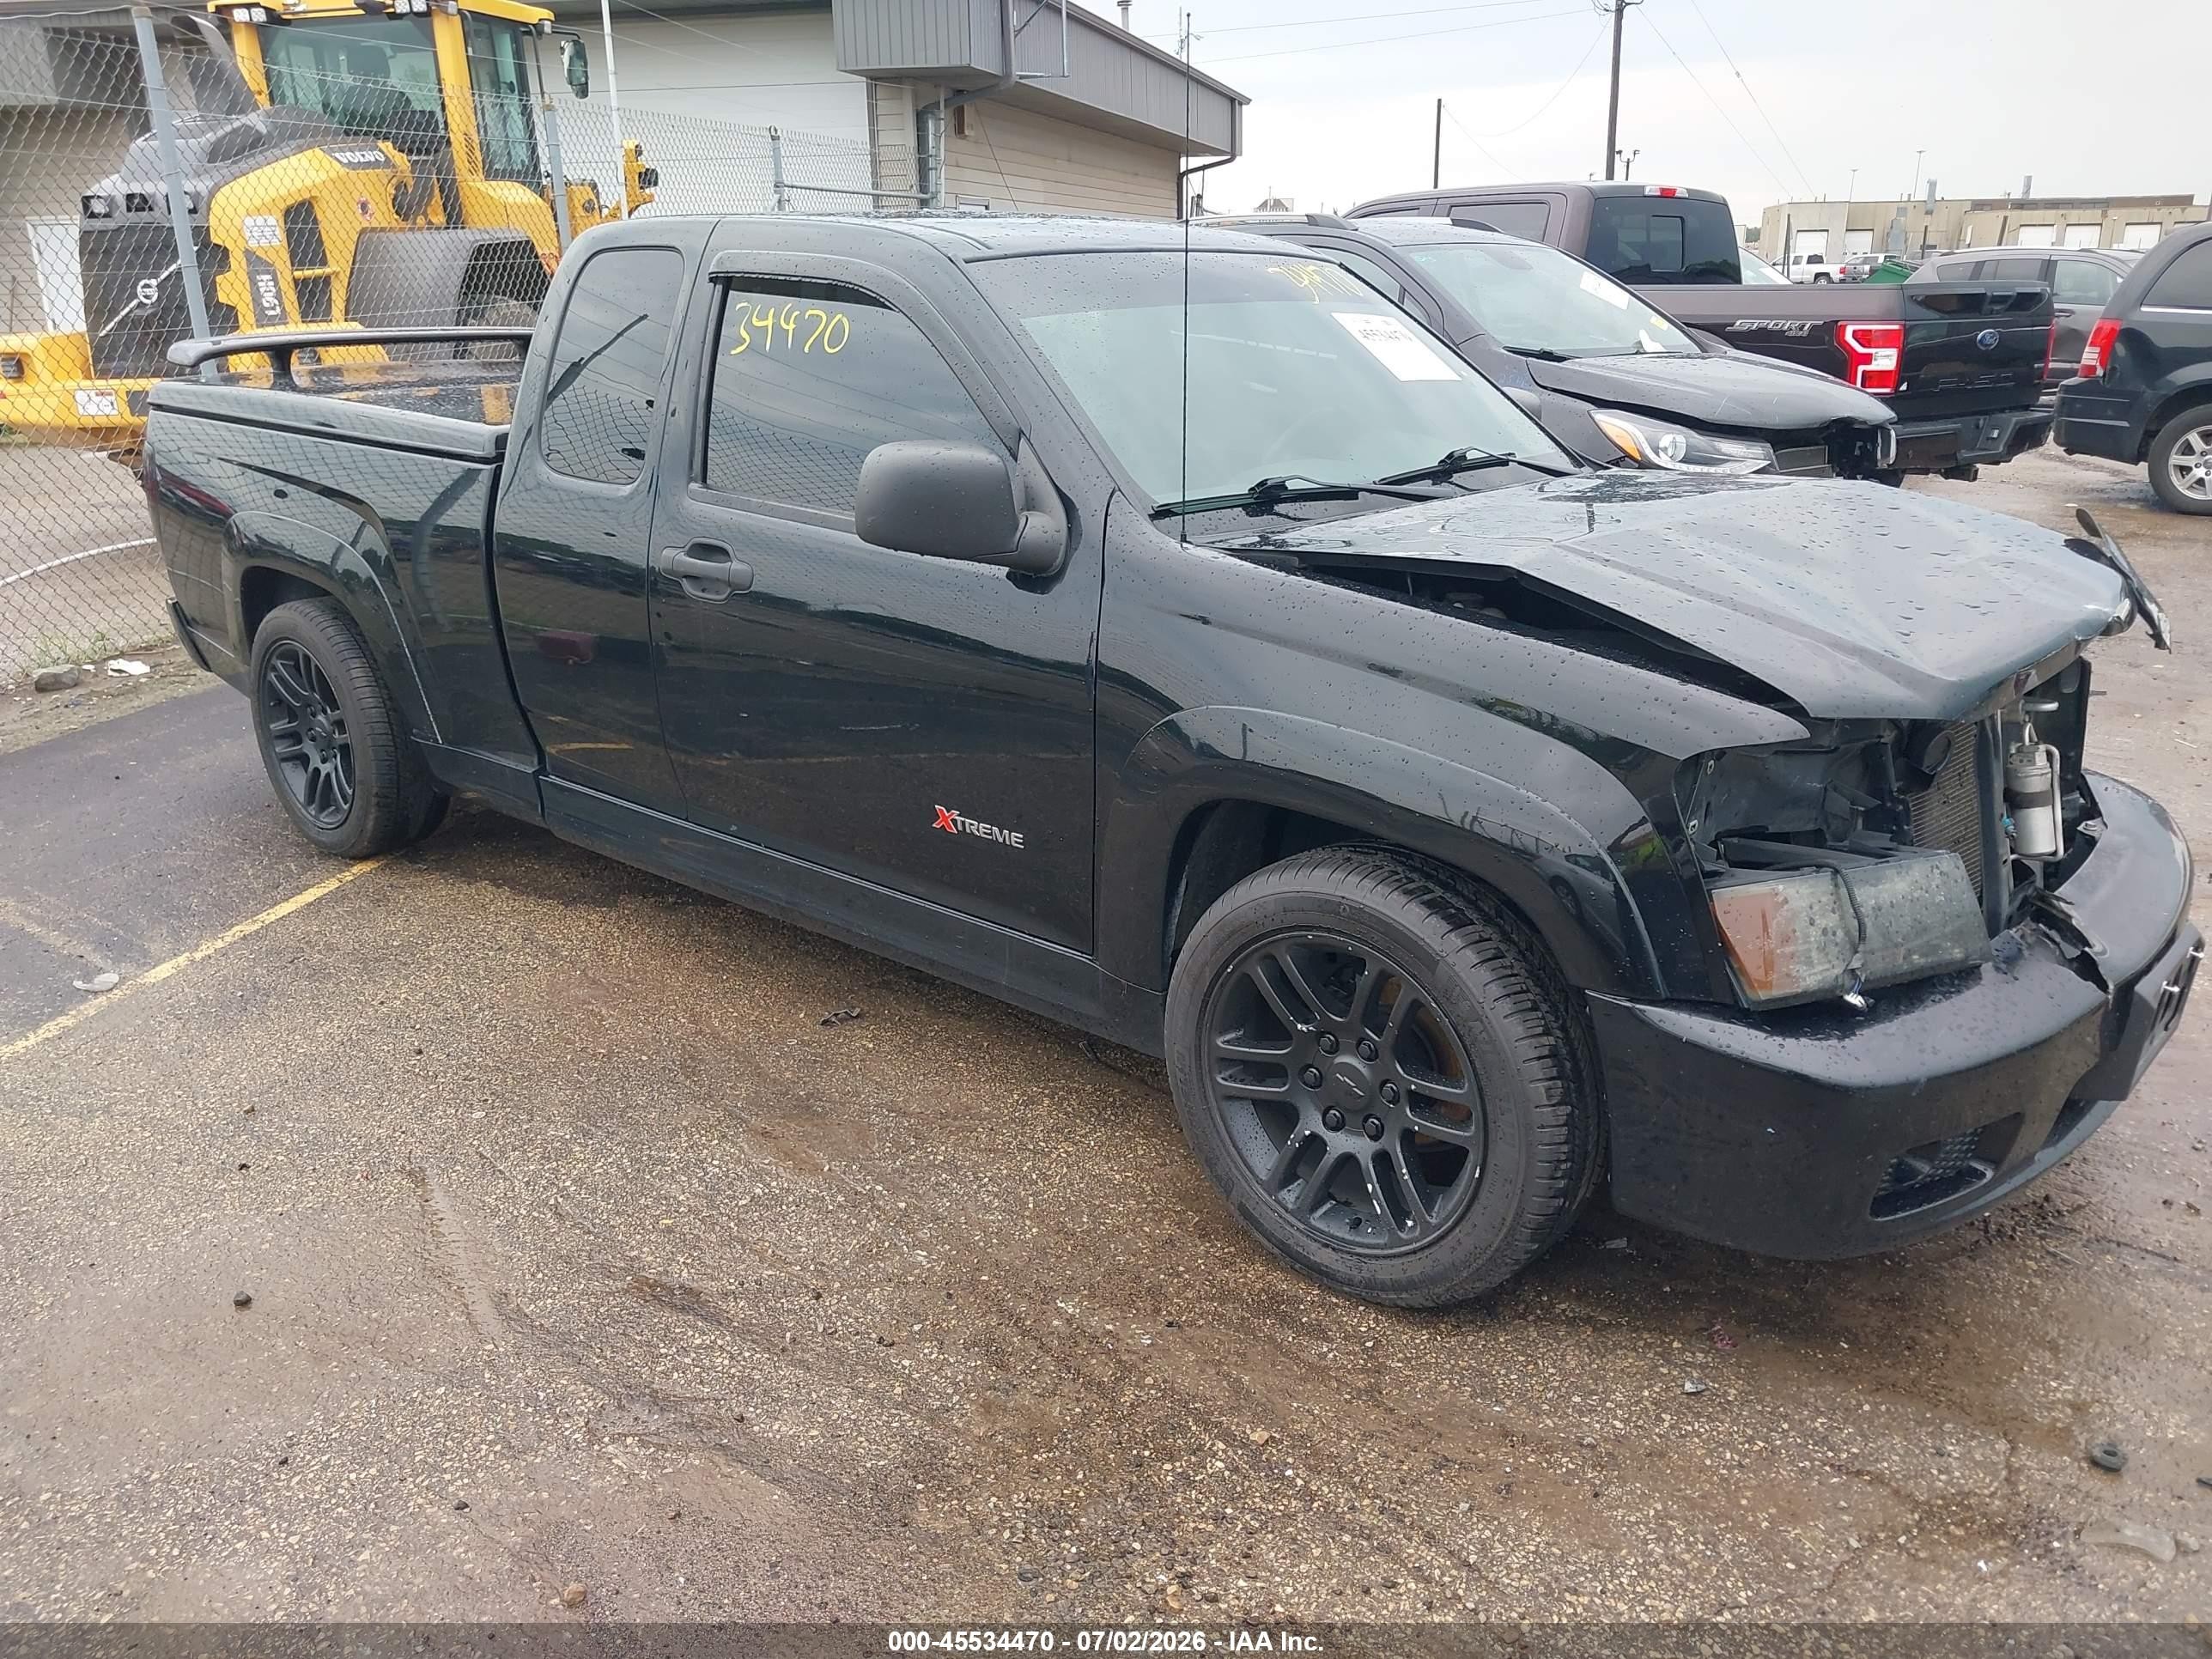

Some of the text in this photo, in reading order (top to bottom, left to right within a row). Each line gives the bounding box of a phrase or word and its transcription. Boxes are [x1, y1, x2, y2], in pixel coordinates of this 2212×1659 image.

[332, 150, 386, 163] VOLVO
[730, 302, 851, 355] 34470
[1724, 319, 1825, 332] SPORT
